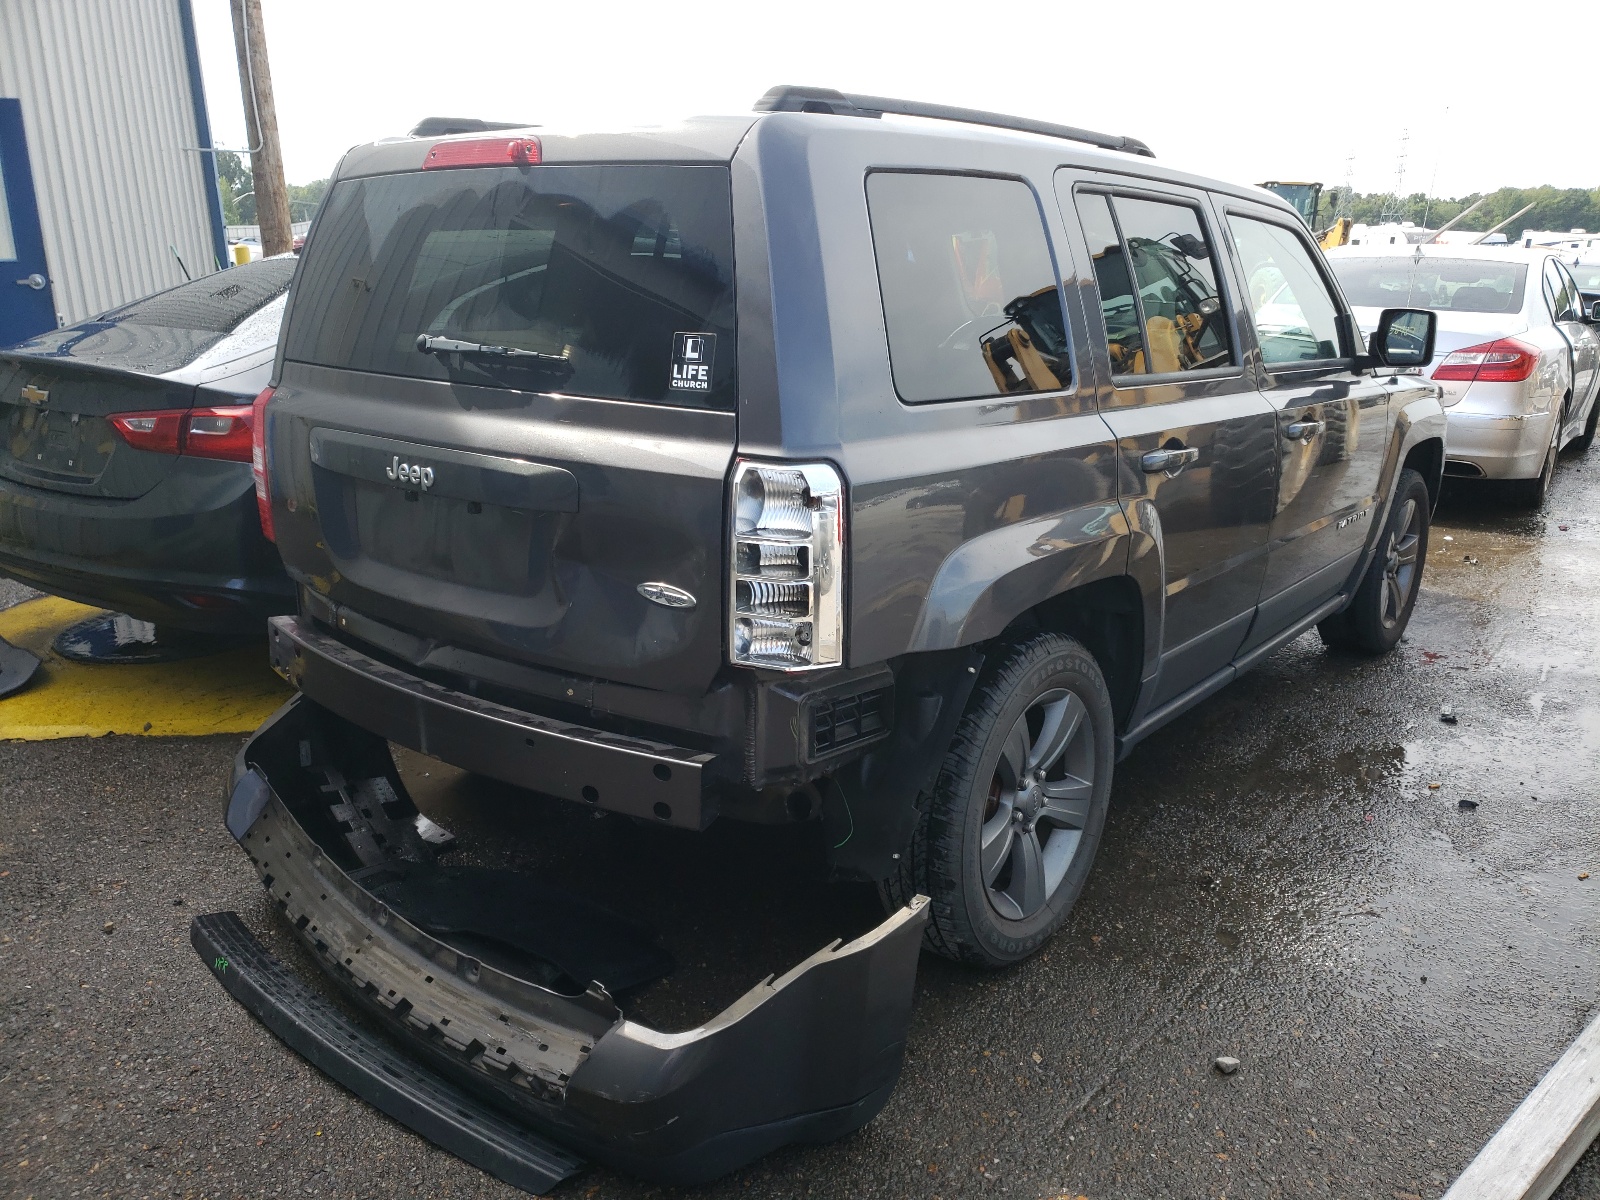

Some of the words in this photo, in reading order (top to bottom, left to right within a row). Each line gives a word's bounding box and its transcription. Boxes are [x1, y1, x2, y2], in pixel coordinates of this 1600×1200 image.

[672, 379, 708, 389] CHURCH
[673, 364, 709, 380] LIFE
[386, 456, 434, 491] Jeep
[1031, 657, 1102, 690] Firestone
